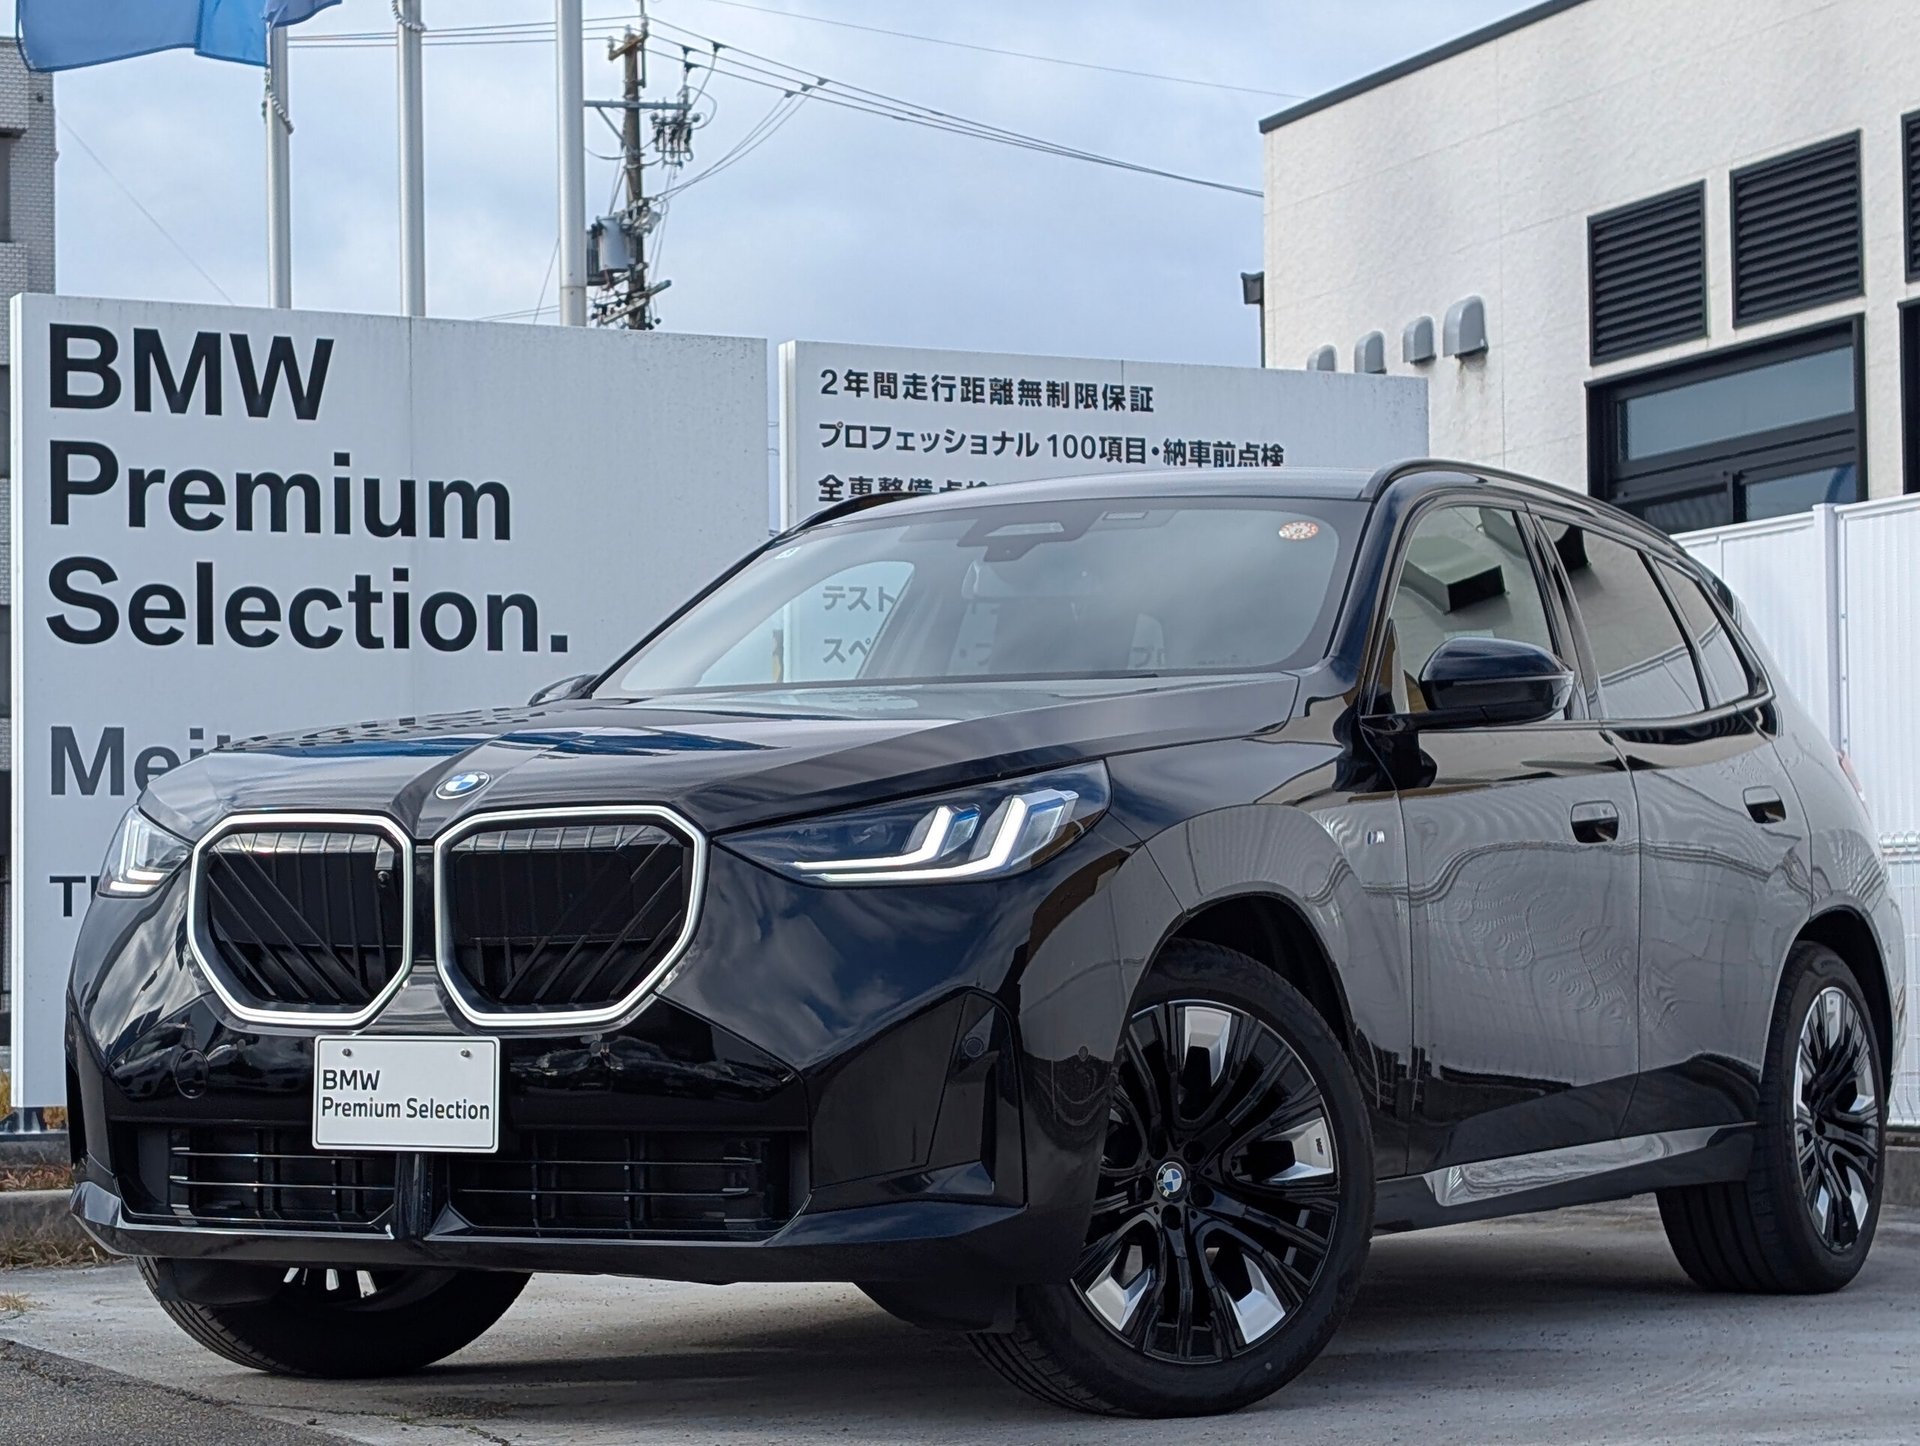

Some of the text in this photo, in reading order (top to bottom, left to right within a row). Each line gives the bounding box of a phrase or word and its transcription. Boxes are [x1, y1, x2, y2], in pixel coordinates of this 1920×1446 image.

[48, 324, 335, 421] BMW
[820, 369, 1154, 413] 2年間走行距離無制限保証
[49, 440, 512, 541] Premium
[46, 557, 569, 653] Selection.
[321, 1096, 490, 1120] Premium Selection
[322, 1069, 381, 1091] BMW
